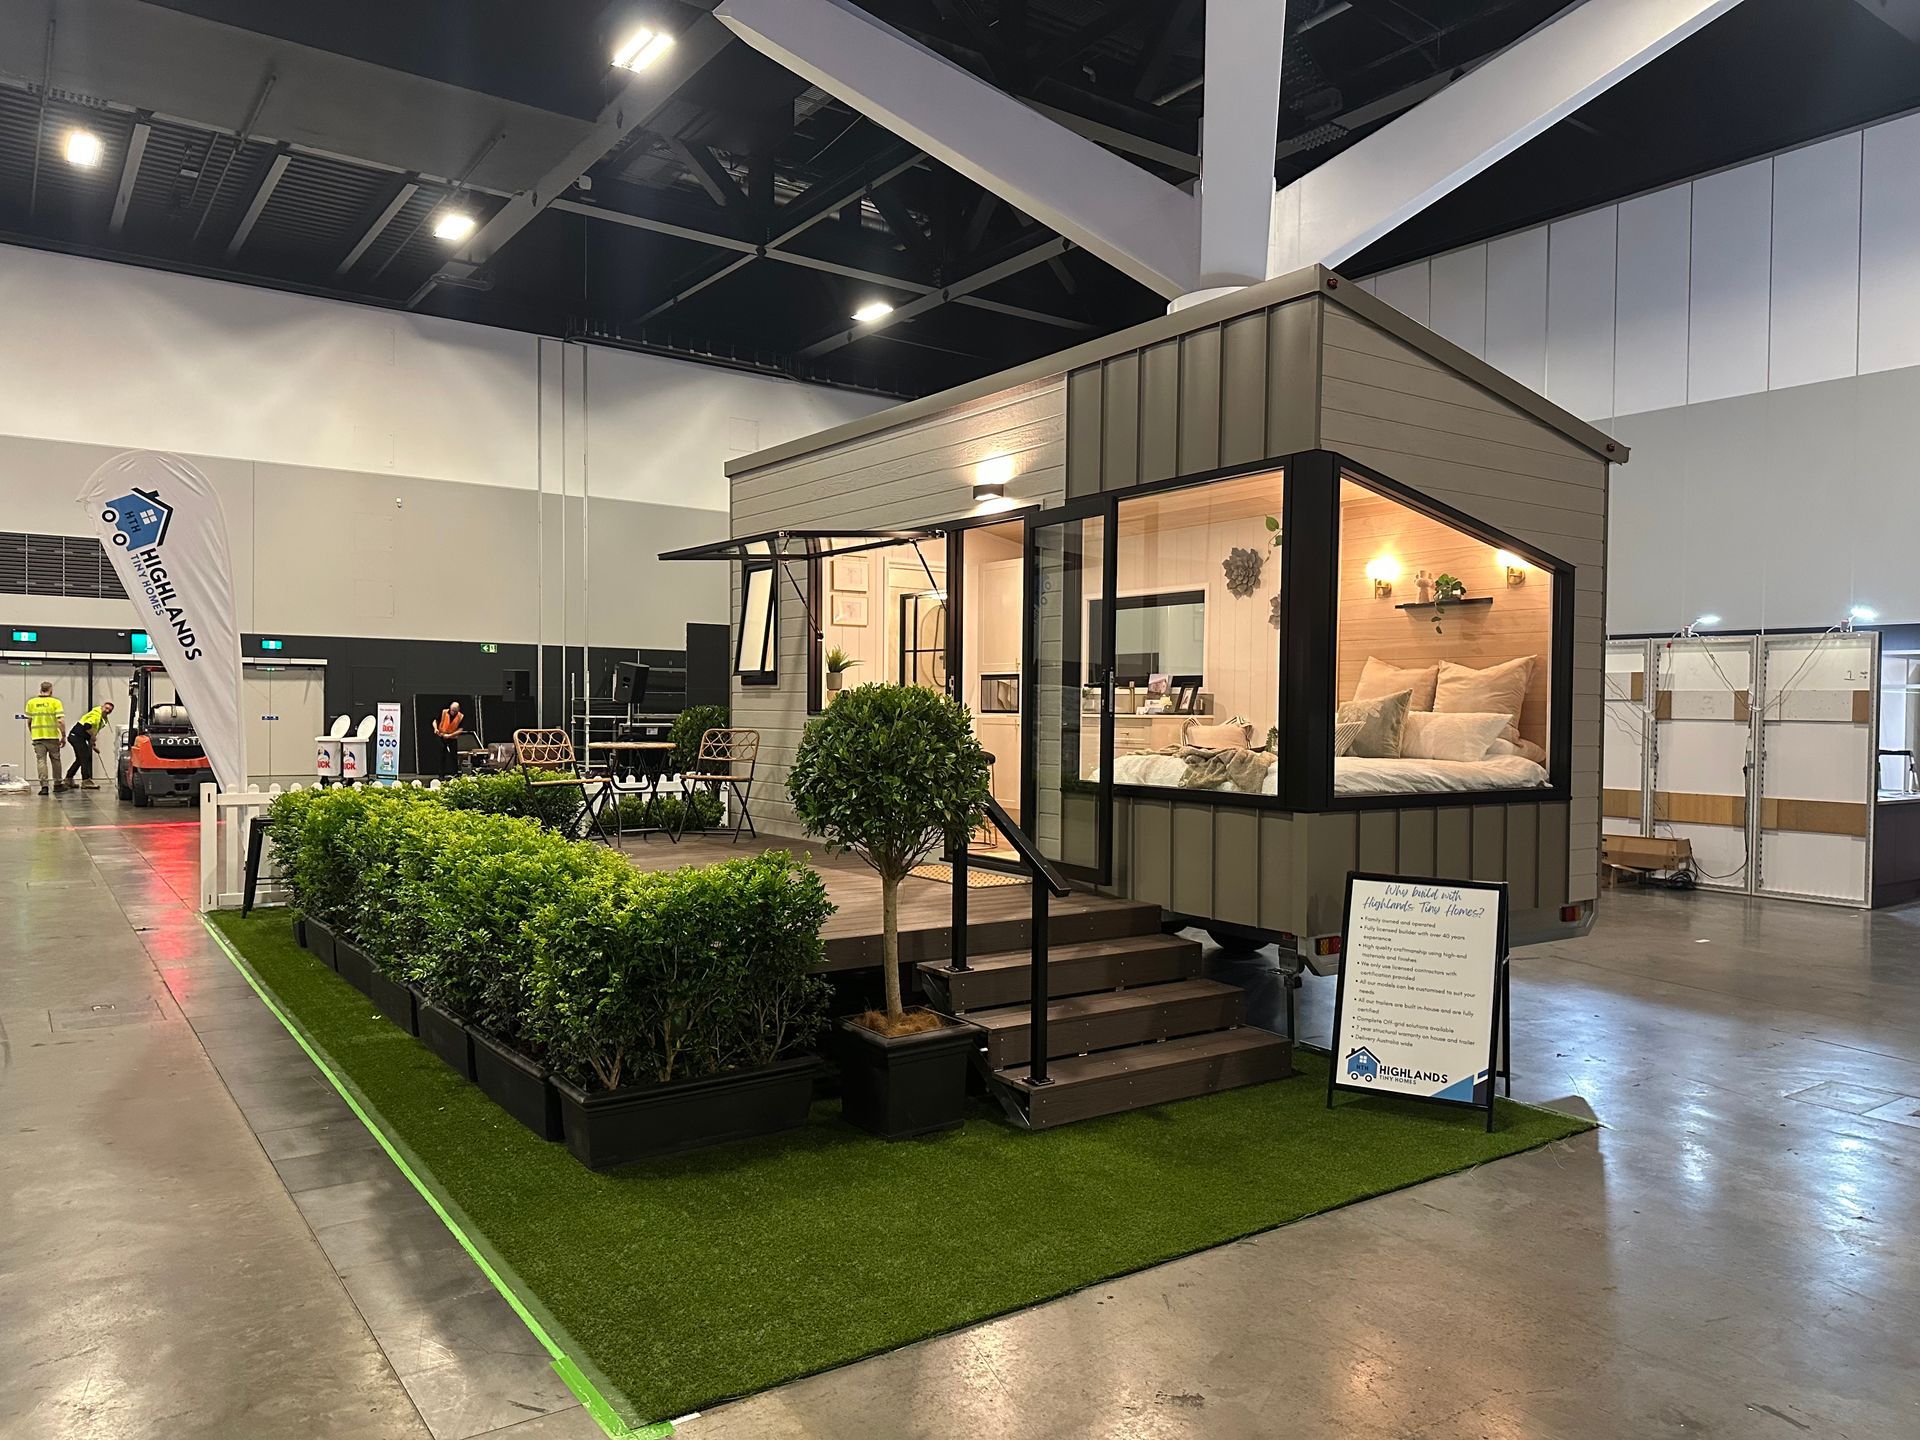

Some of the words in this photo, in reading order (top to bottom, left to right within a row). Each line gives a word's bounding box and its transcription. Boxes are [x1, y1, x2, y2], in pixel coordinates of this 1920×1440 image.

[124, 510, 142, 533] HTH
[130, 554, 148, 578] TINY
[142, 580, 164, 616] HOMES
[140, 548, 202, 660] HIGHLANDS
[317, 760, 330, 768] UCK
[1385, 884, 1408, 897] Why
[1412, 886, 1439, 900] build
[1441, 890, 1462, 901] with
[1362, 896, 1414, 912] Highlands
[1419, 902, 1440, 914] Tiny
[1444, 904, 1485, 918] Homes?
[1365, 916, 1380, 924] Family
[1357, 1016, 1382, 1024] Complete
[1463, 1010, 1473, 1018] fully
[1355, 1034, 1375, 1043] Delivery
[1376, 1037, 1399, 1045] Australia
[1380, 1065, 1448, 1084] HIGHLANDS
[1395, 1077, 1417, 1085] HOMES
